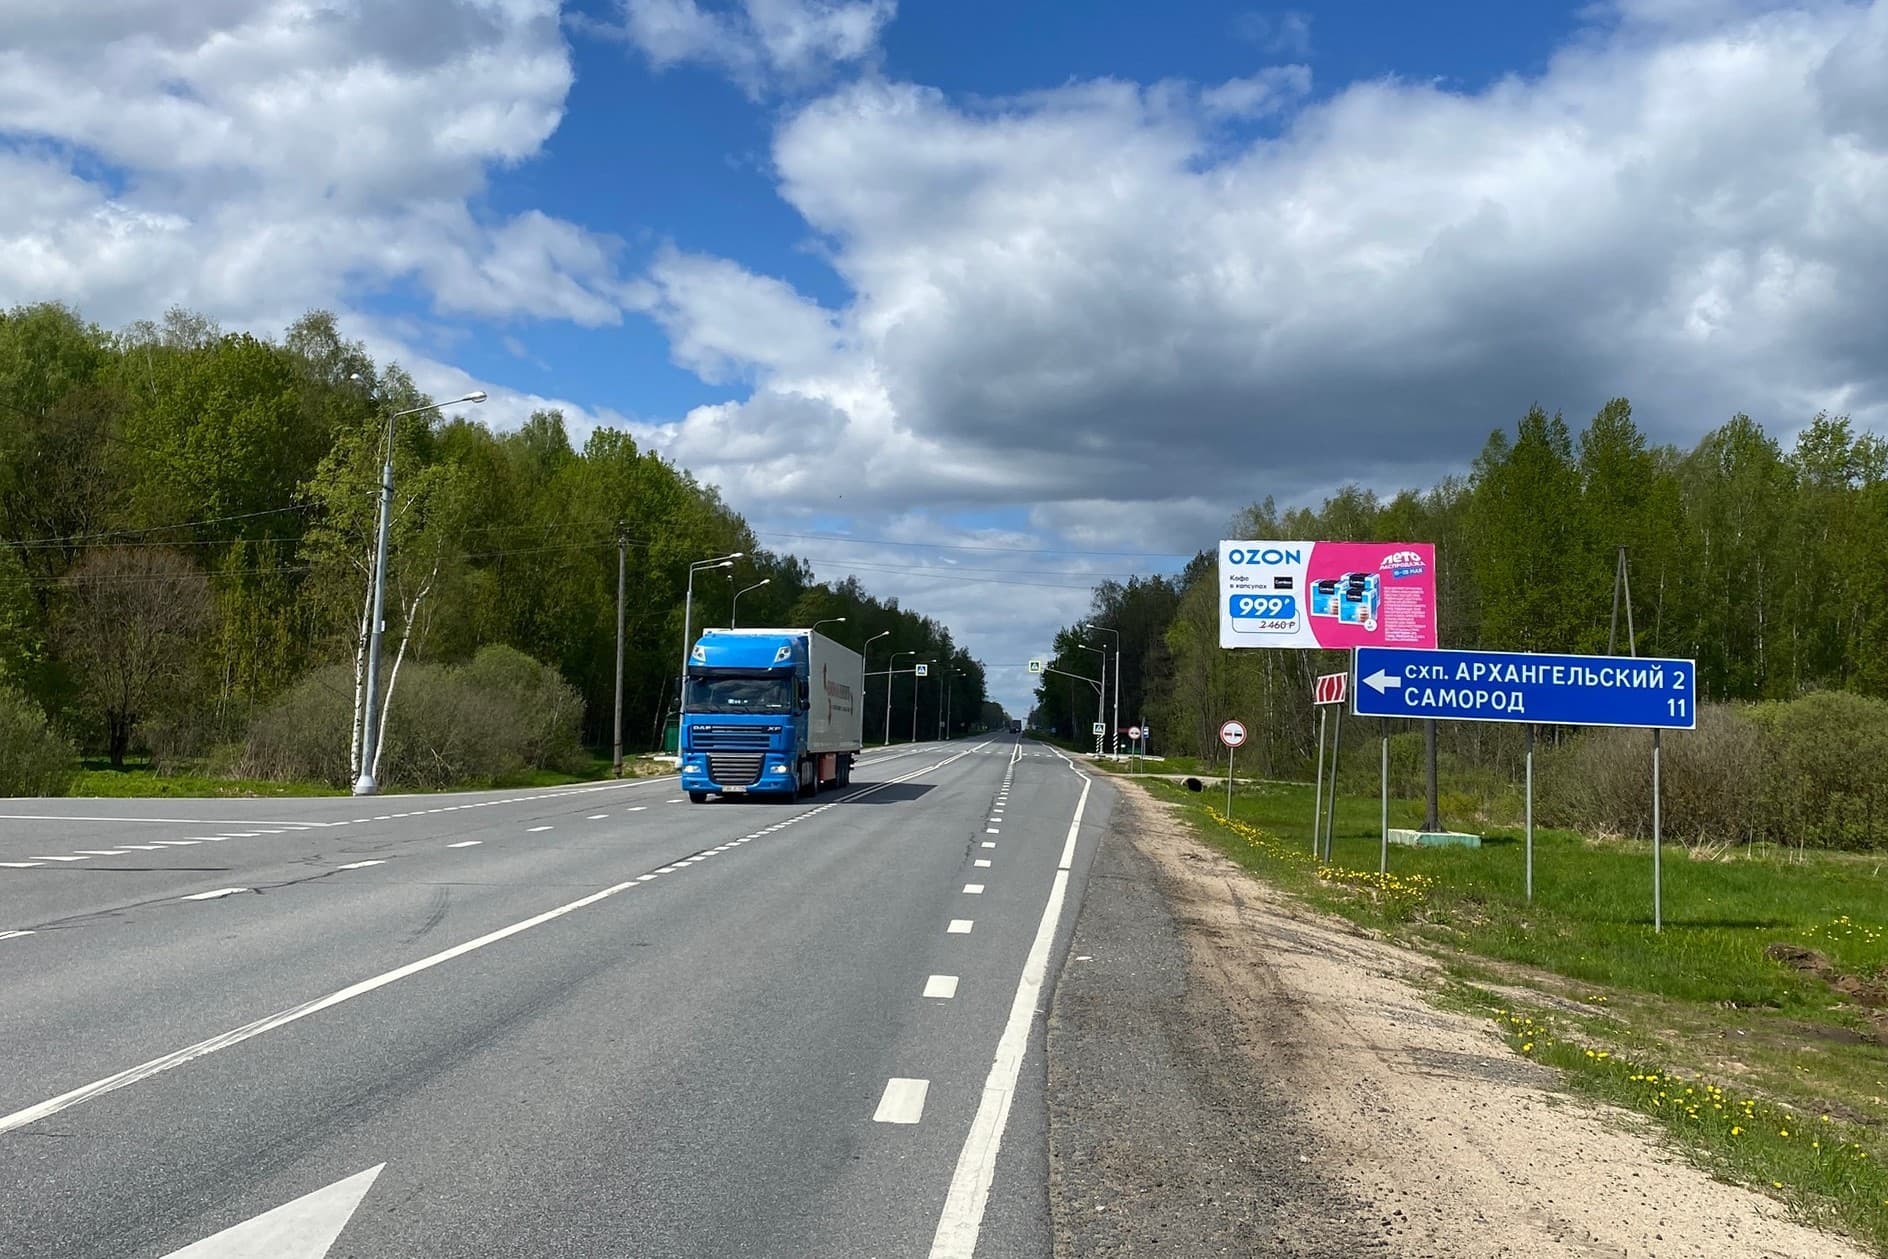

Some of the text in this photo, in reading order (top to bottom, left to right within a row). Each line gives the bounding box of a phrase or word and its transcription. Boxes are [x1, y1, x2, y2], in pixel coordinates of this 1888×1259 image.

[1229, 549, 1300, 565] OZON
[1405, 662, 1685, 690] схп. АРХАНГЕЛЬСКИЙ 2
[1404, 687, 1686, 717] САМОРОД 11
